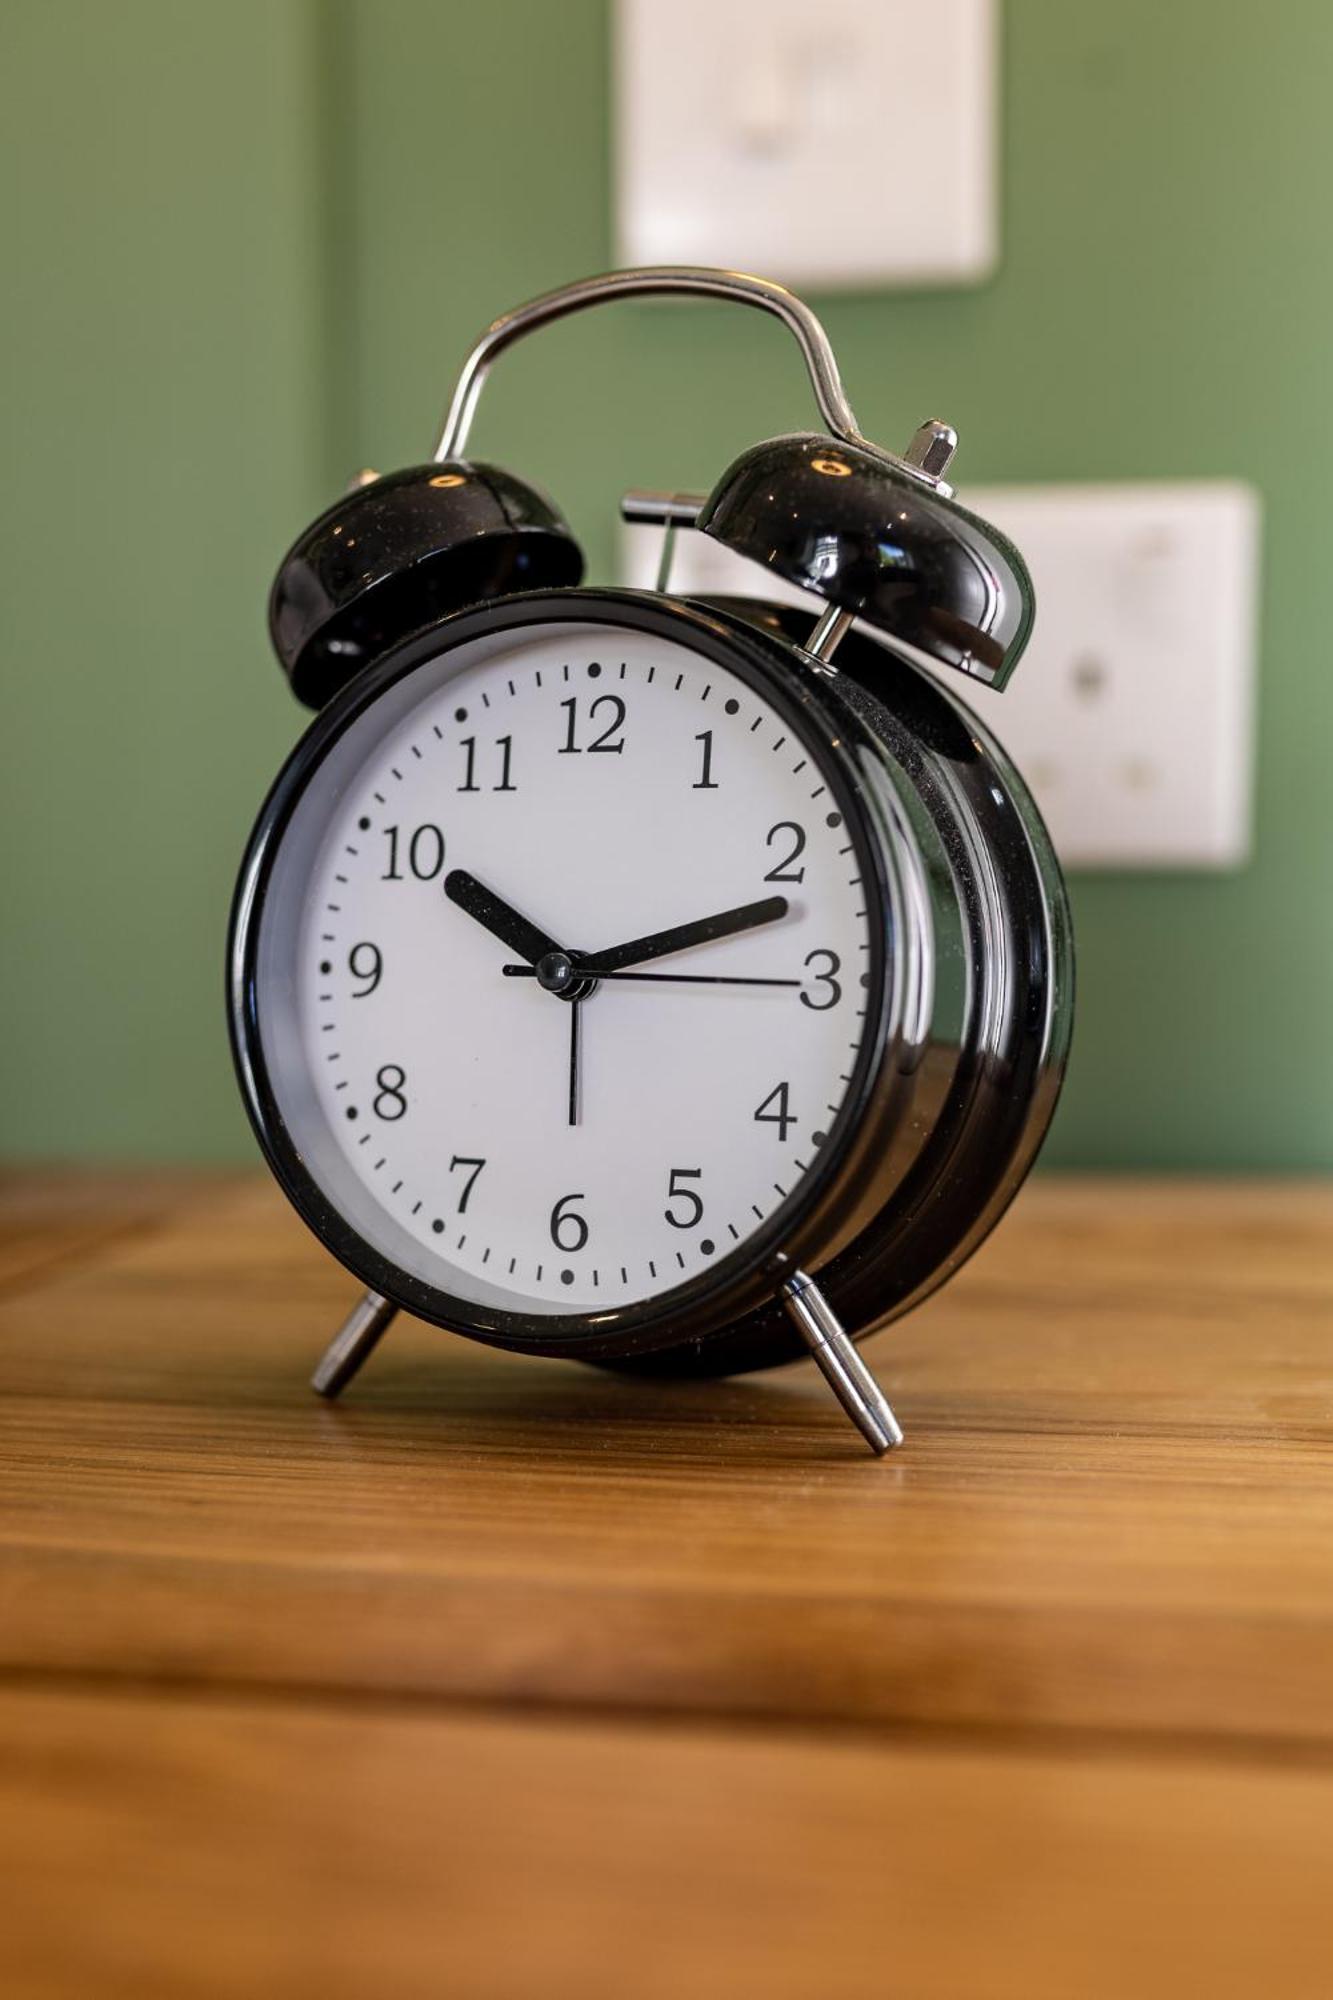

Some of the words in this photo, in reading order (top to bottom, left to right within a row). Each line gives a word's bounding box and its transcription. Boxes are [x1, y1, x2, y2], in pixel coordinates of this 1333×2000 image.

[557, 694, 627, 755] 12
[456, 735, 518, 792] 11
[692, 730, 719, 789] 1
[381, 823, 446, 882] 10
[763, 821, 806, 883] 2
[348, 942, 383, 998] 9
[799, 949, 842, 1011] 3
[372, 1064, 408, 1122] 8
[753, 1081, 798, 1142] 4
[449, 1155, 487, 1214] 7
[664, 1168, 704, 1229] 5
[550, 1193, 589, 1253] 6
